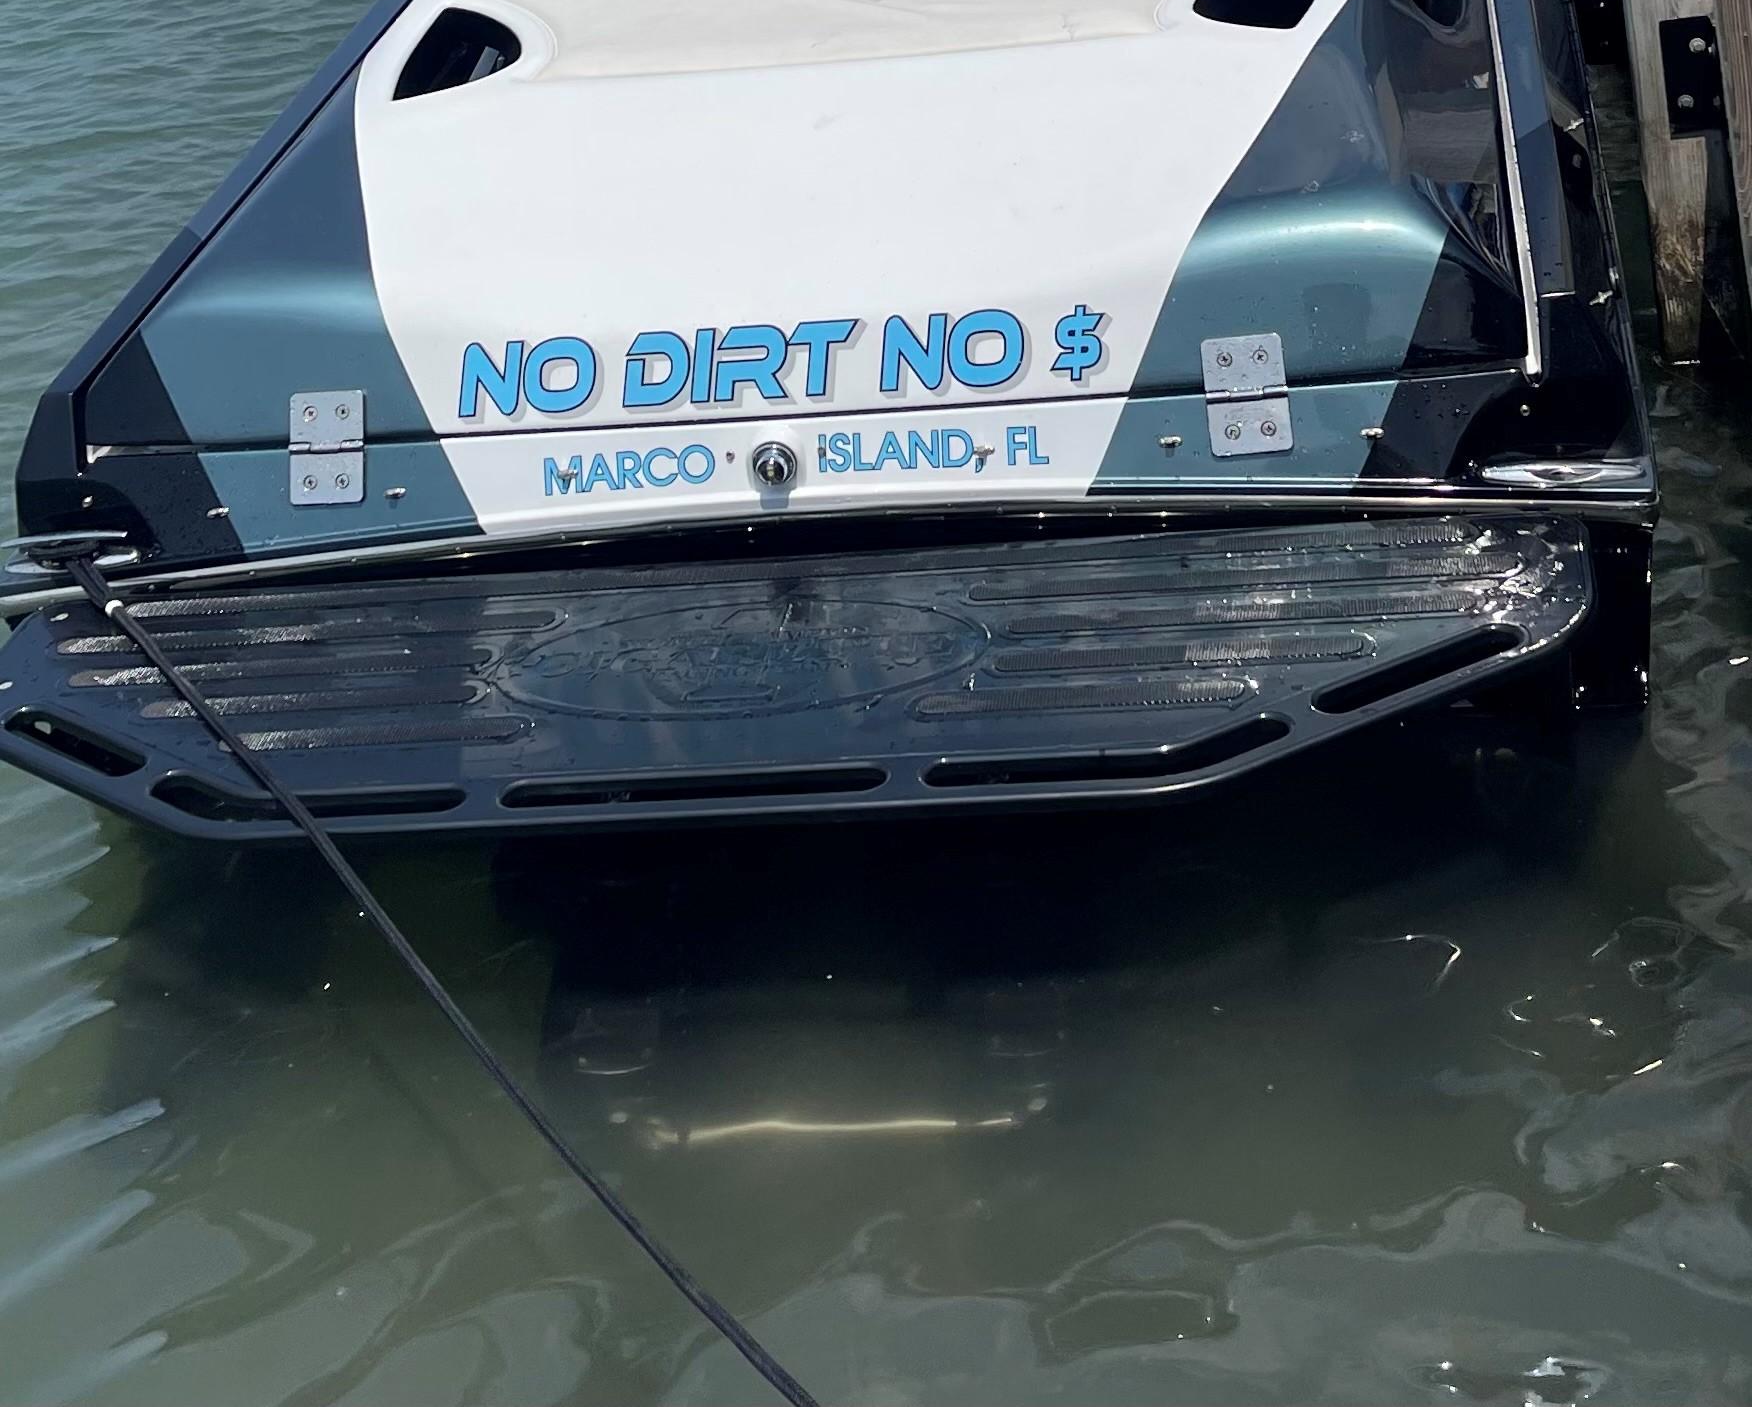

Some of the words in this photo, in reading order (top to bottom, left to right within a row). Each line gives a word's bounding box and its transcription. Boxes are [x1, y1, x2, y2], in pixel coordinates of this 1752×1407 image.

[458, 336, 597, 418] NO
[622, 318, 861, 408] DIRT
[879, 308, 1025, 392] NO
[1049, 304, 1106, 382] $
[543, 444, 716, 496] MARCO
[817, 429, 985, 473] ISLAND,
[1006, 425, 1050, 466] FL
